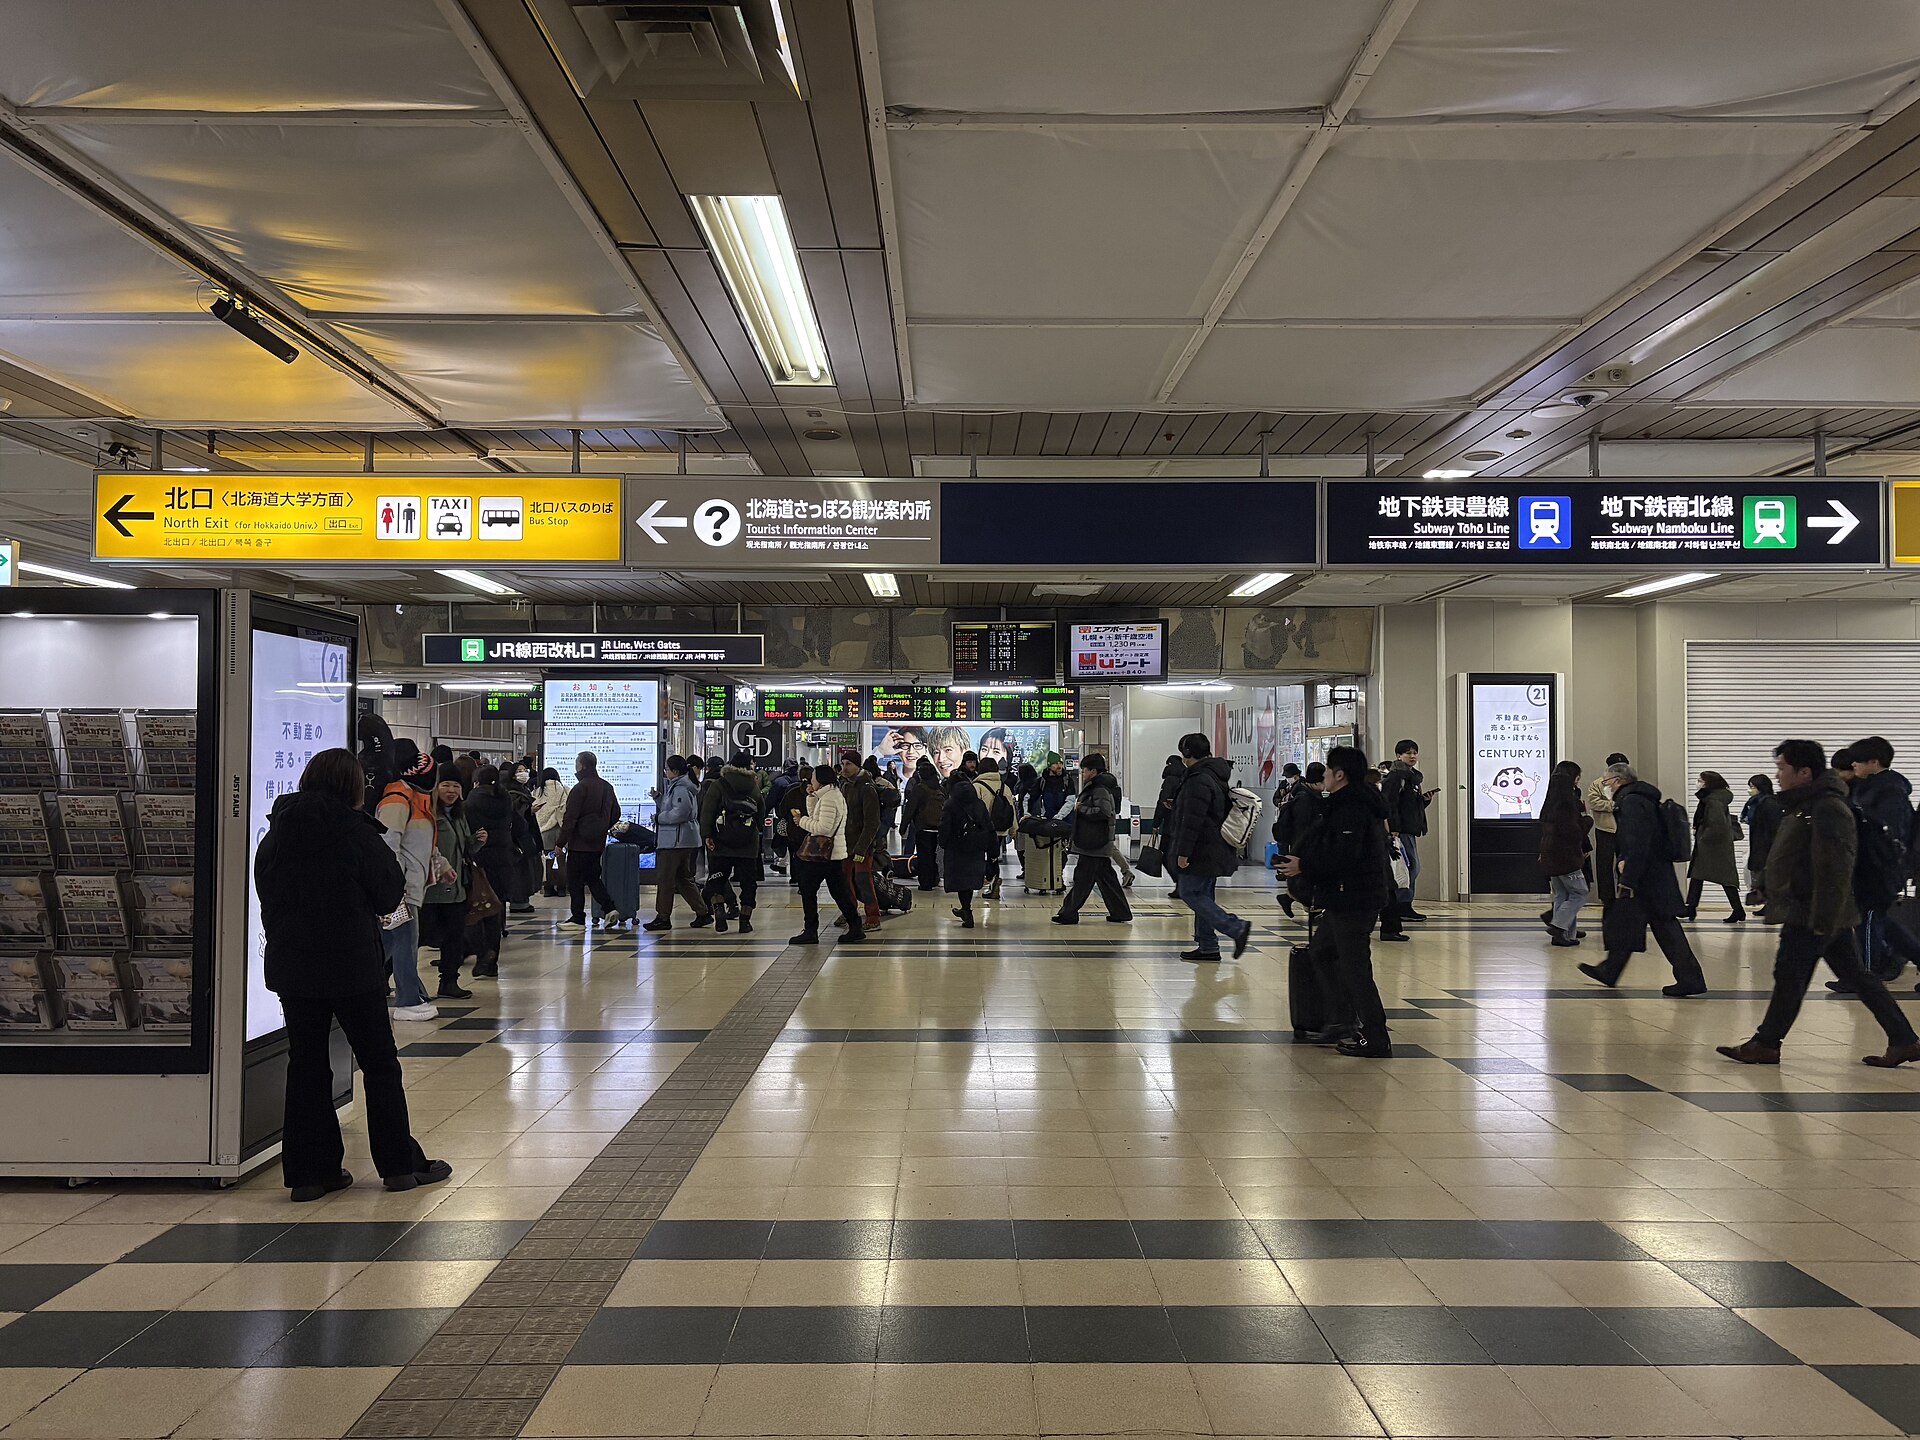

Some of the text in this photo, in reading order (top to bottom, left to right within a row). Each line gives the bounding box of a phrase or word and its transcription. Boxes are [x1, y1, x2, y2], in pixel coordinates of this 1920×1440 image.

[165, 486, 213, 510] 北口
[431, 498, 468, 510] TAXI
[529, 501, 614, 514] 北口バスのりば
[746, 498, 931, 521] 北海道さっぽろ観光案内所
[1378, 495, 1510, 518] 地下鉄東豊線
[1600, 495, 1734, 518] 地下鉄南北線
[163, 517, 199, 529] North
[205, 517, 229, 529] Exit
[329, 519, 347, 529] 出口
[529, 516, 569, 527] Bus Stop
[745, 523, 878, 536] Tourist Information Center
[1413, 522, 1455, 536] Subway
[1487, 522, 1510, 534] Line
[1611, 522, 1735, 536] Subway Namboku Line
[488, 641, 596, 659] JR線西改札口
[600, 640, 611, 649] JR
[657, 640, 681, 649] Gates
[329, 652, 344, 683] 21
[572, 683, 632, 691] お知らせ
[1533, 688, 1546, 700] 21
[282, 721, 323, 740] 不動産の
[1478, 749, 1546, 758] CENTURY 21
[232, 774, 240, 818] JUST SAILIN
